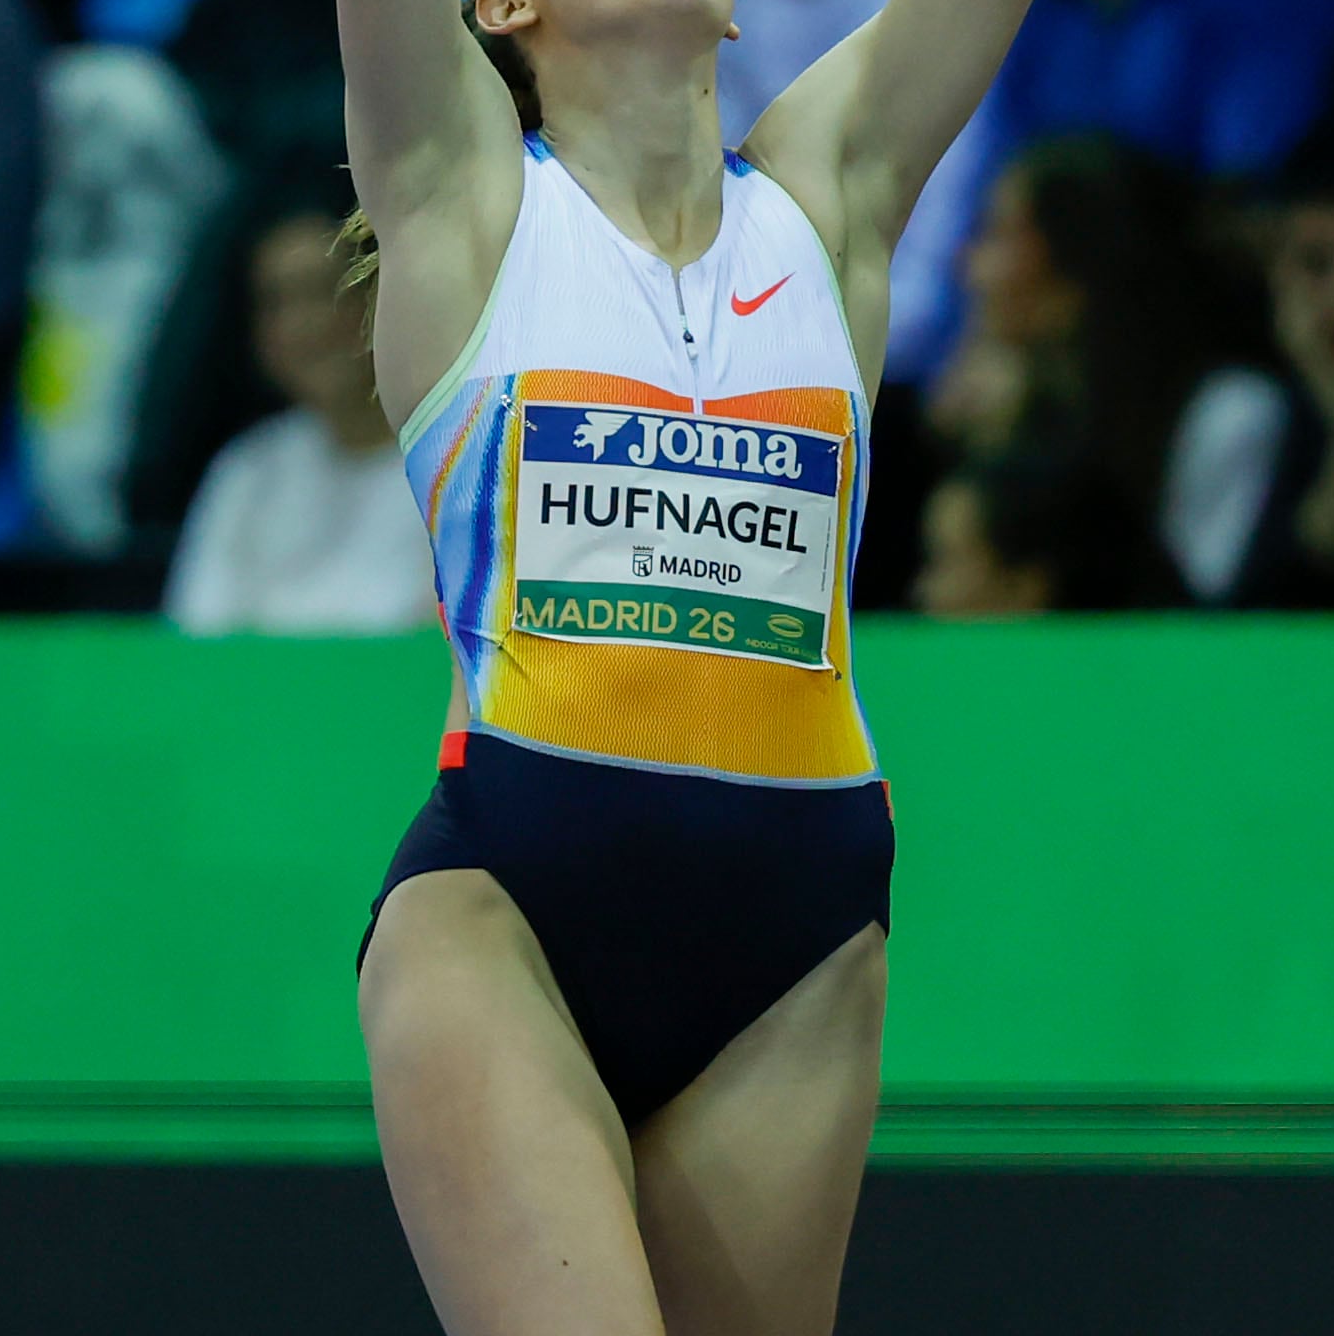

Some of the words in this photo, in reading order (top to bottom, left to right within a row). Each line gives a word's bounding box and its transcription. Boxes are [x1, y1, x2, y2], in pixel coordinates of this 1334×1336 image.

[541, 483, 807, 553] HUFNAGEL
[660, 555, 742, 586] MADRID
[521, 597, 677, 634] MADRID
[688, 607, 735, 642] 26
